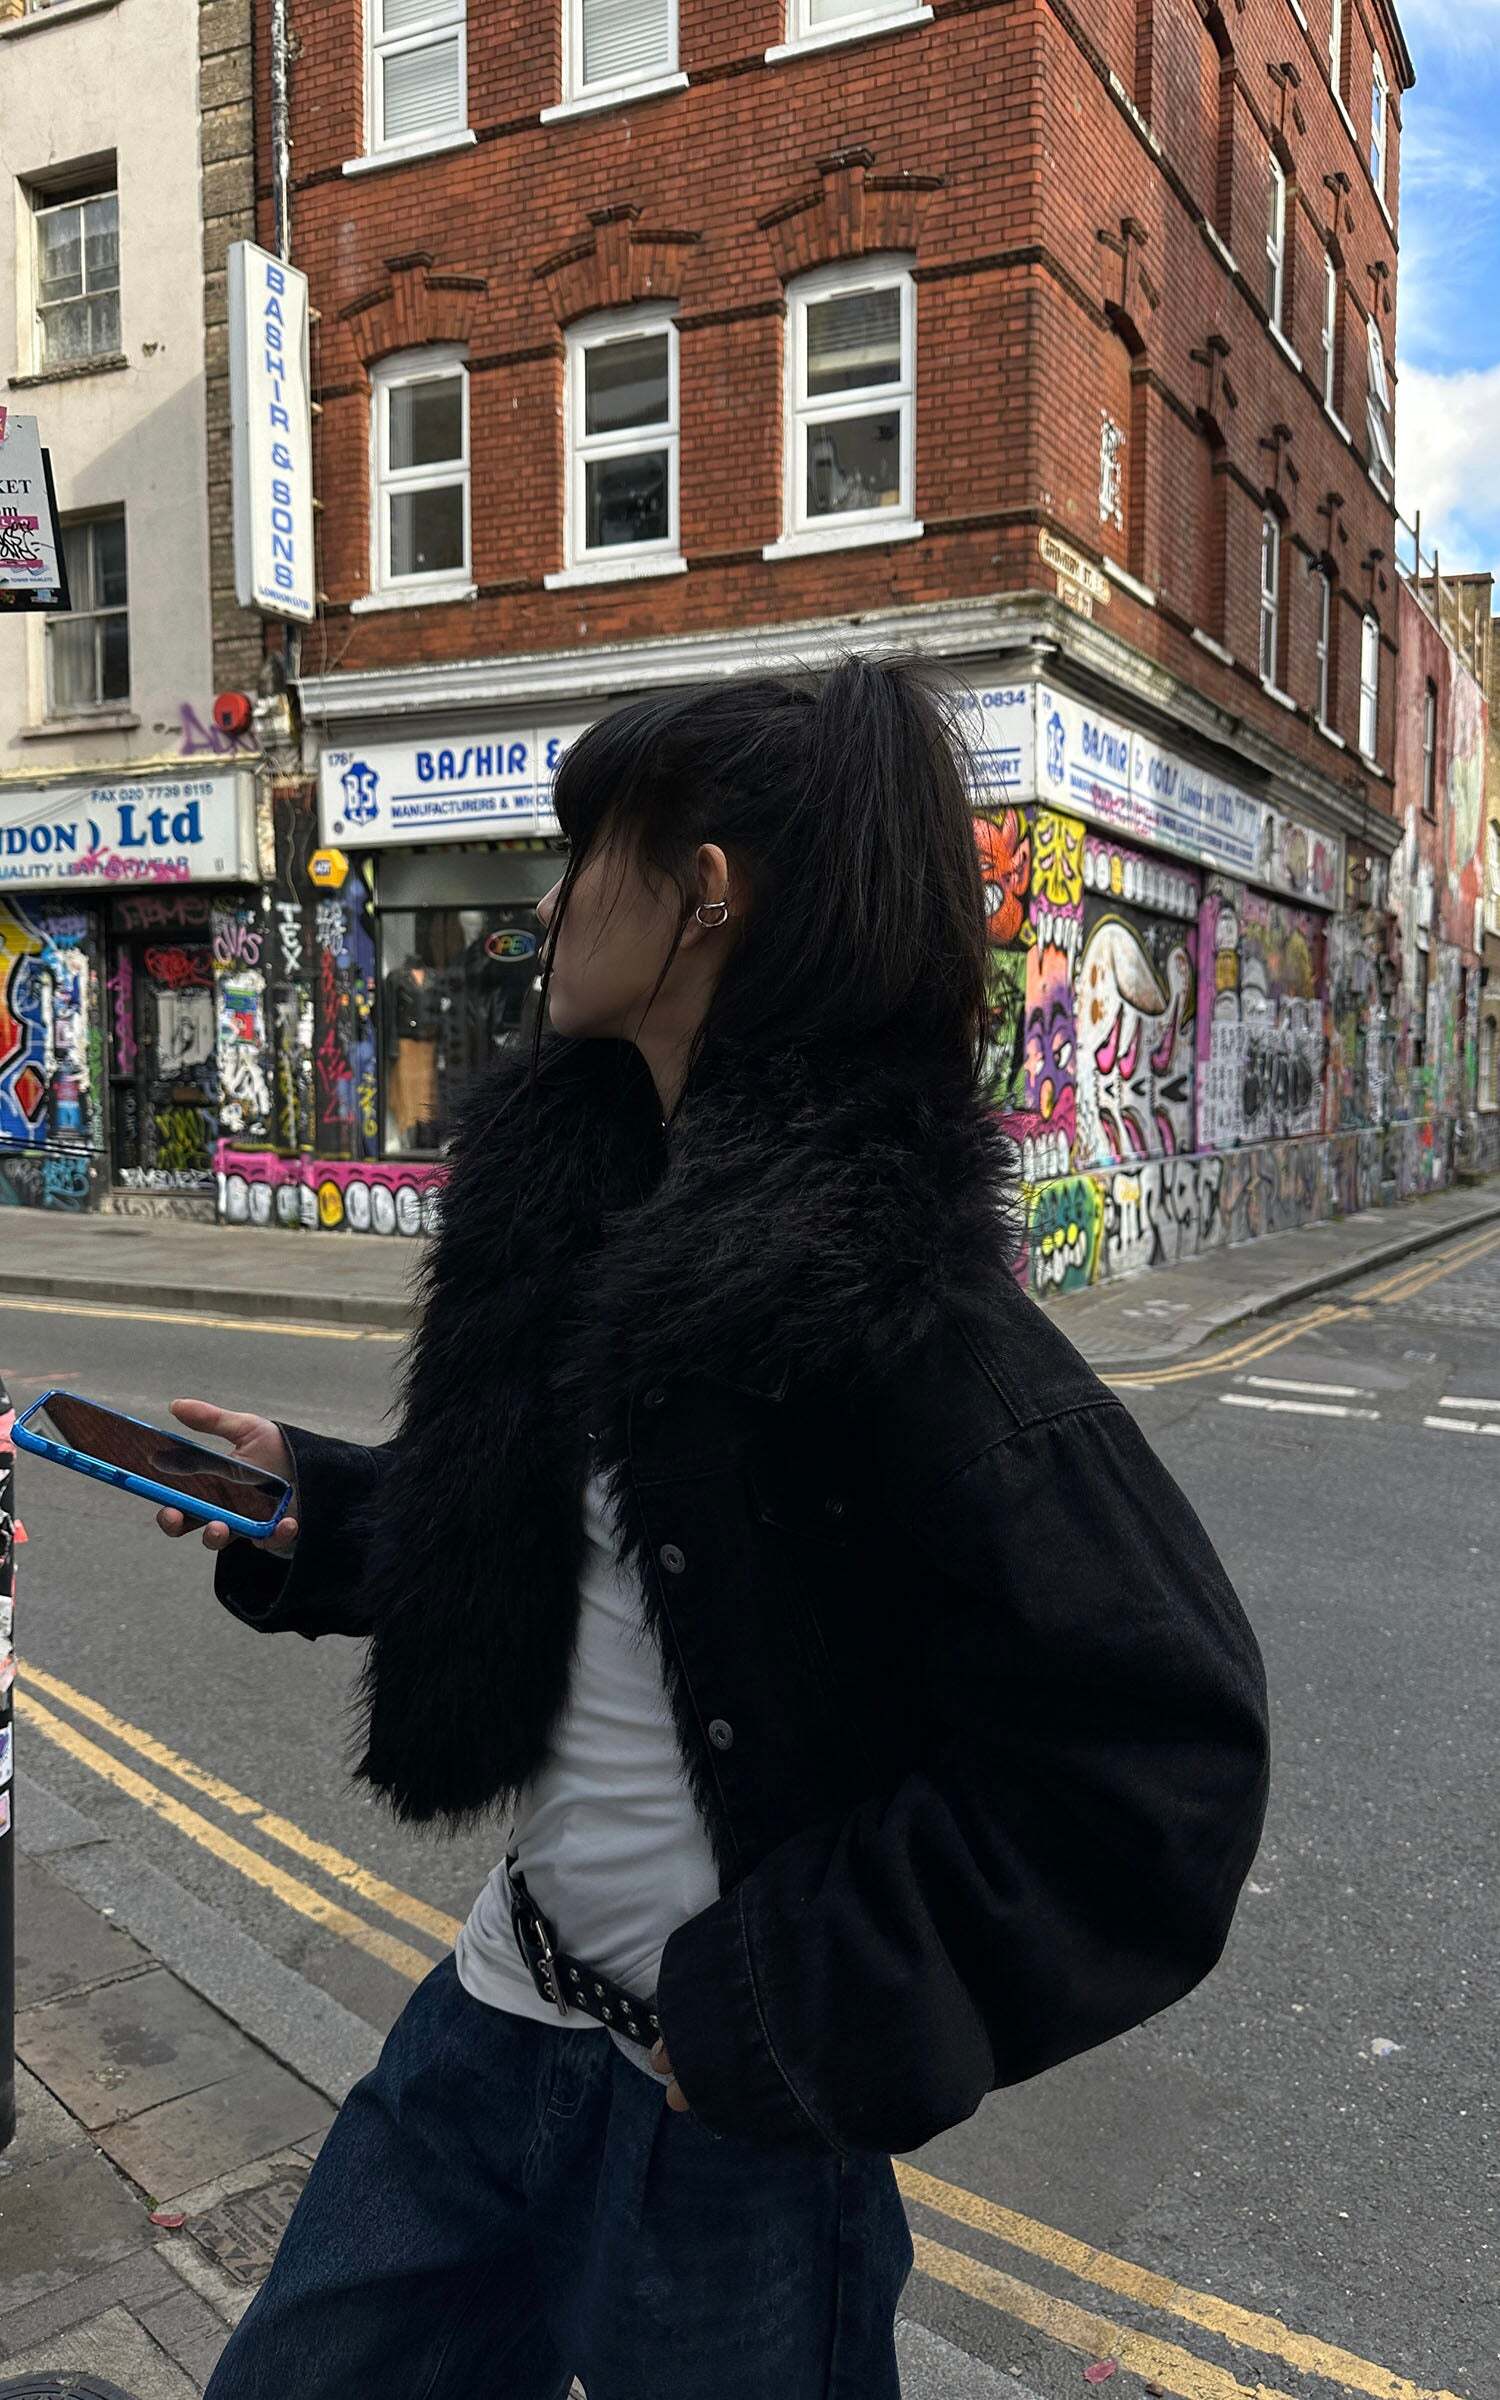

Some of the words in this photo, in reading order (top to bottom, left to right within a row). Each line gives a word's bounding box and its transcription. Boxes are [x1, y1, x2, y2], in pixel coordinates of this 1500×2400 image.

[264, 263, 289, 433] BASHIR
[271, 479, 293, 589] SONS
[982, 690, 1025, 708] 0834
[416, 742, 528, 783] BASHIR
[91, 789, 117, 803] FAX
[118, 787, 144, 801] 020
[390, 796, 498, 820] MANUFACTURERS
[0, 822, 78, 856] DON
[117, 800, 203, 848] Ltd
